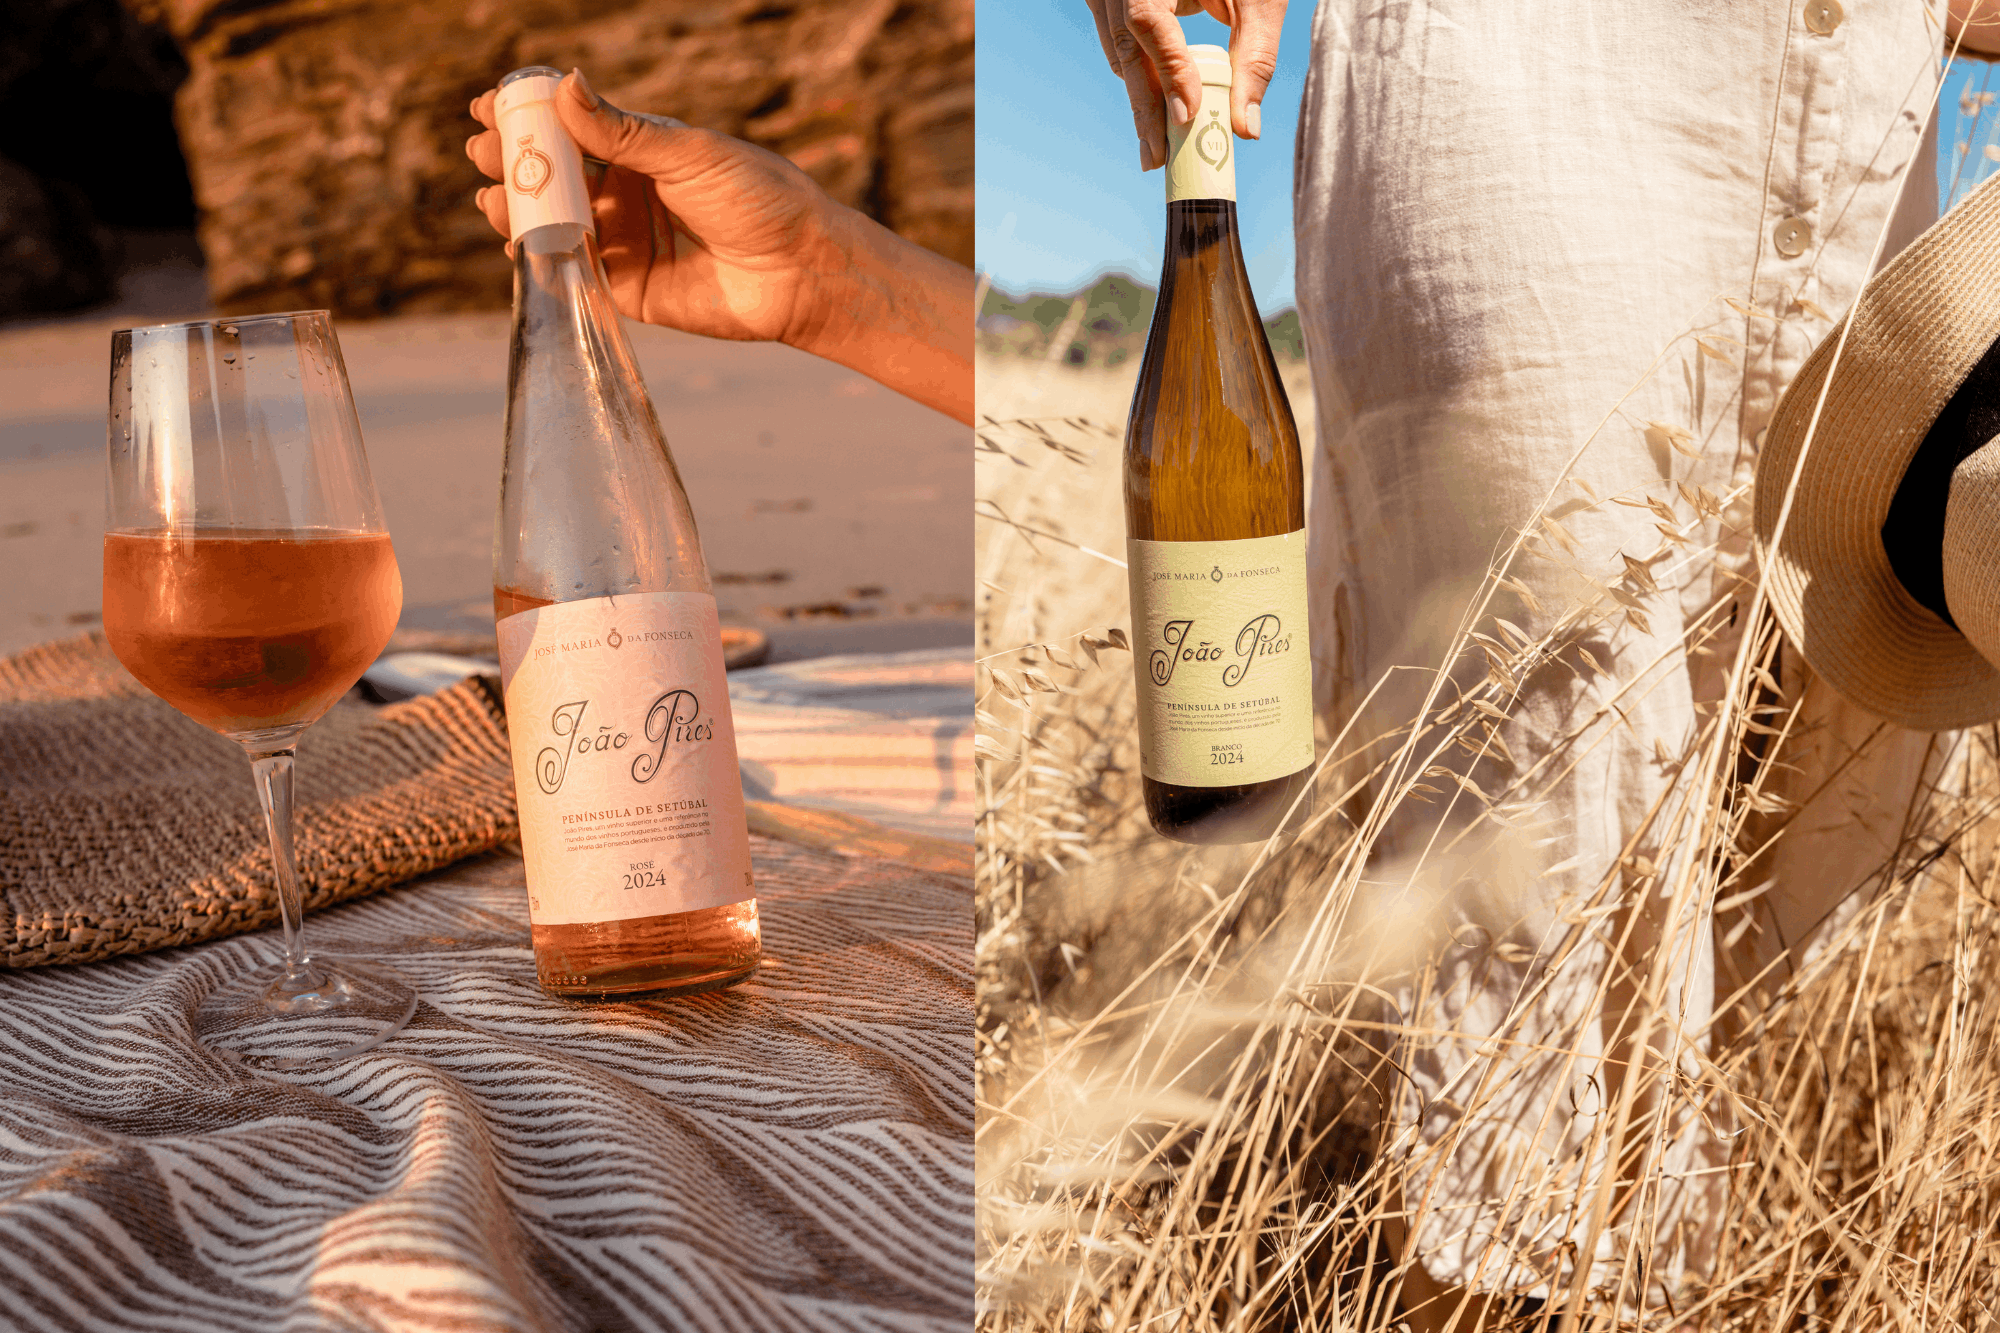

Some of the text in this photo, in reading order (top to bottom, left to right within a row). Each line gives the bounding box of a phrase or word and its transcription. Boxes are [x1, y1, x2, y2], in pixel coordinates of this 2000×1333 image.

[1207, 141, 1223, 151] VII
[1174, 572, 1206, 580] MARIA
[1241, 566, 1280, 577] FONSECA
[534, 631, 694, 660] JOSÉ MARIA DA FONSECA
[1150, 620, 1224, 687] João
[1167, 696, 1281, 711] PENÍNSULA DE SETÚBAL
[536, 700, 631, 795] João
[1211, 743, 1242, 751] BRANCO
[1210, 750, 1244, 765] 2024
[562, 799, 708, 825] PENÍNSULA DE SETÚBAL
[598, 832, 619, 840] vinhos
[669, 822, 698, 831] produzido
[607, 822, 624, 830] vinho
[626, 819, 652, 827] superior
[604, 840, 629, 848] Fonseca
[630, 837, 649, 845] desde
[629, 860, 656, 871] ROSÉ
[622, 868, 667, 890] 2024
